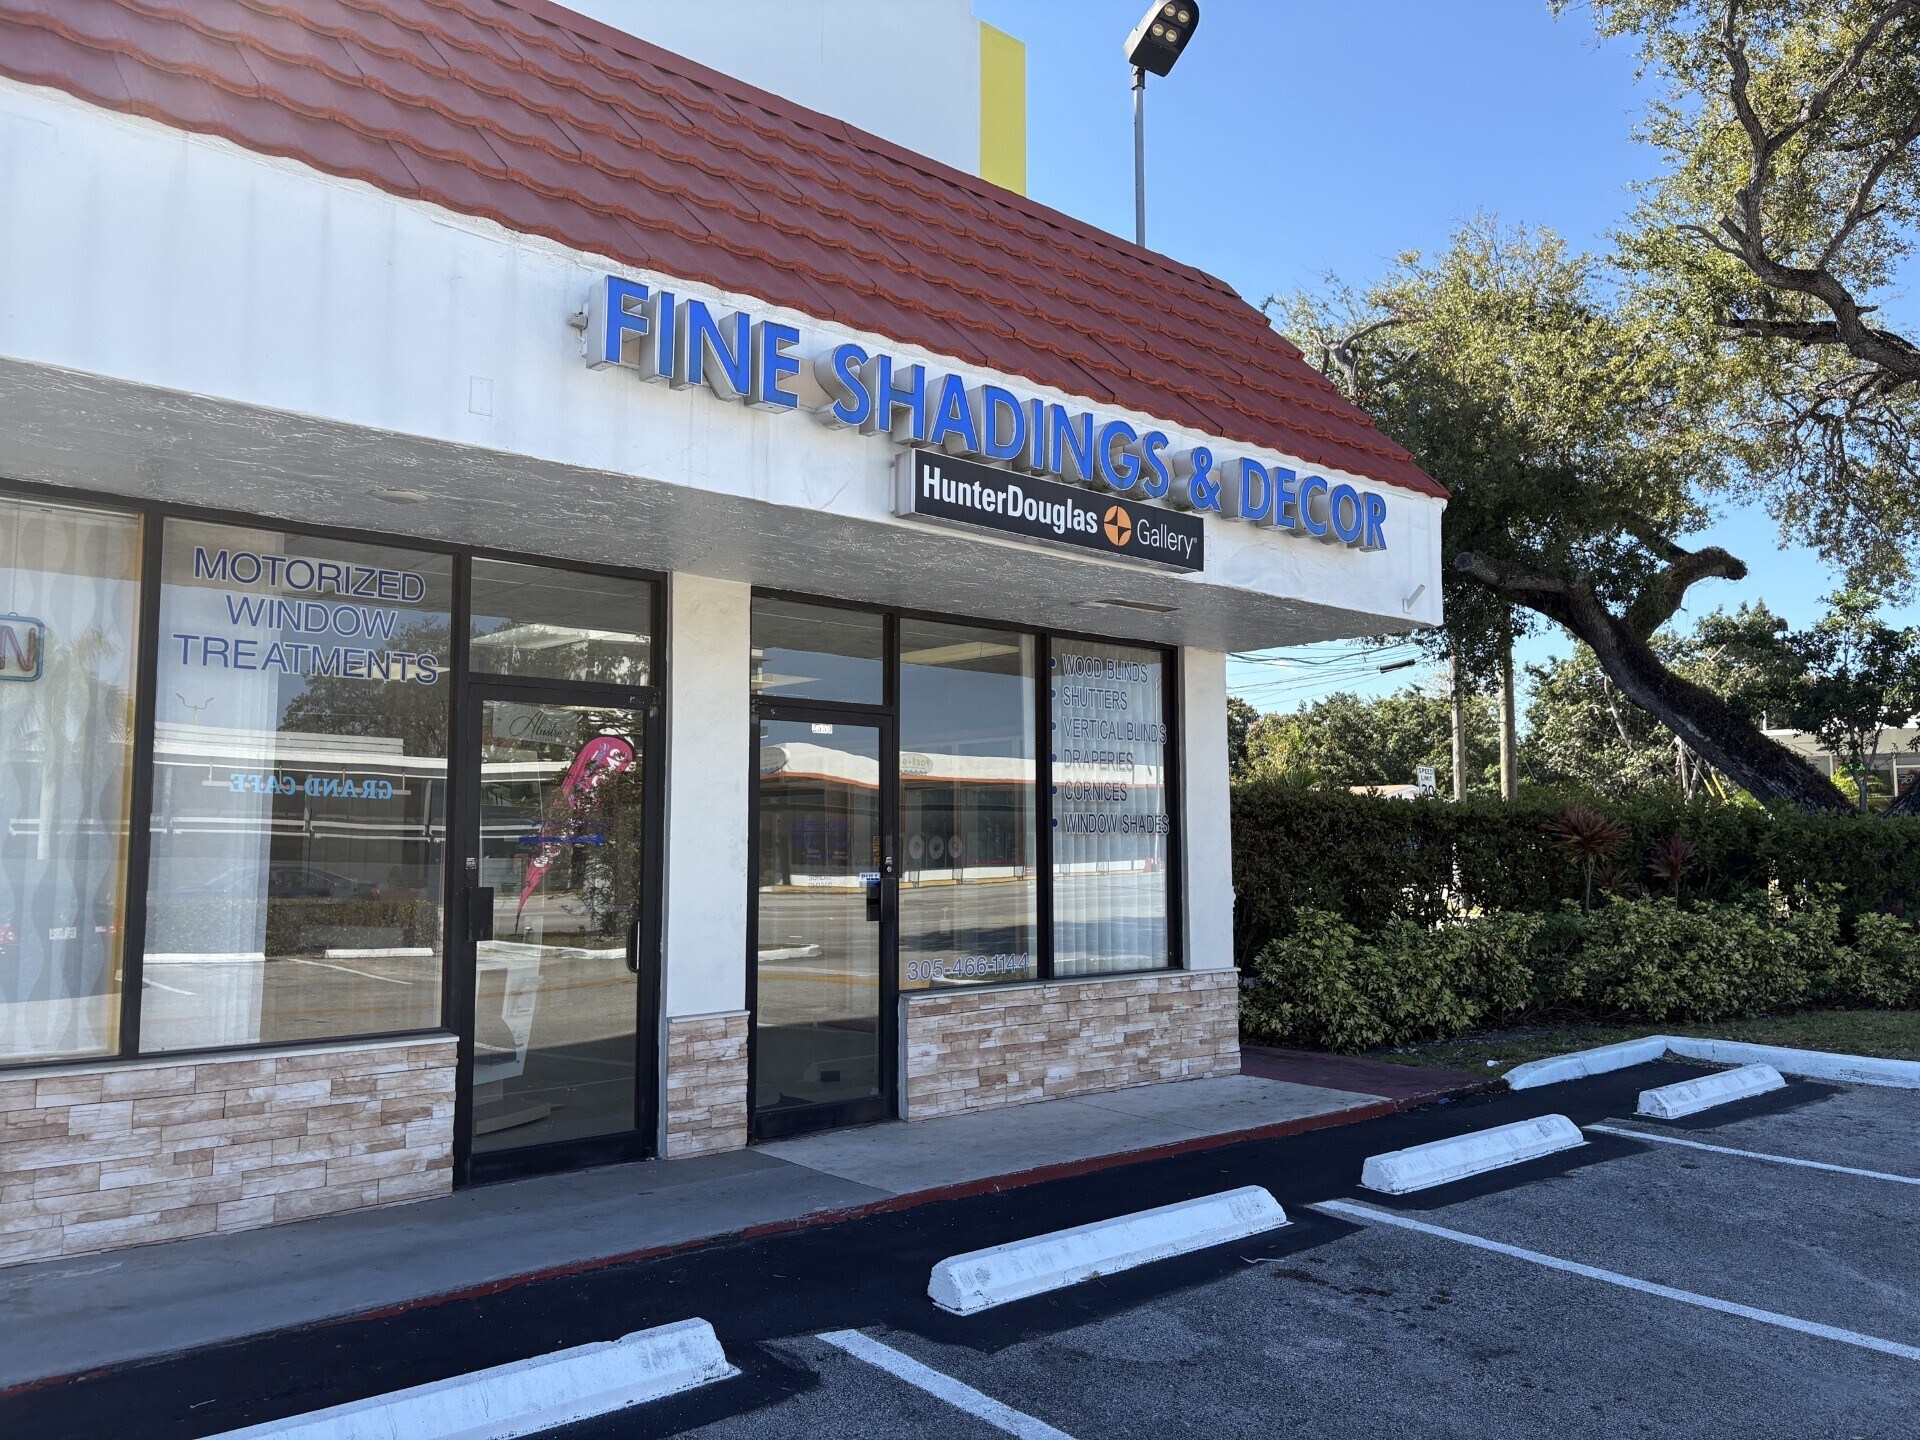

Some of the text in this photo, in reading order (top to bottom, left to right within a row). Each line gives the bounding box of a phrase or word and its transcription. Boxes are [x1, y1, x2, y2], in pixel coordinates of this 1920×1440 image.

[603, 274, 1387, 550] FINE SHADINGS & DECOR
[922, 464, 1098, 534] HunterDouglas
[193, 546, 425, 602] MOTORIZED
[225, 594, 398, 640] WINDOW
[172, 633, 438, 685] TREATMENTS
[1062, 654, 1148, 683] WOOD BLINDS
[1063, 686, 1128, 711] SHUTTERS
[1063, 717, 1167, 744] VERTICAL BLINDS
[1063, 748, 1134, 772] DRAPERIES
[1418, 767, 1434, 775] SPEED
[1063, 780, 1128, 802] CORNICES
[1064, 812, 1169, 834] WINDOW SHADES
[906, 952, 1029, 982] 305-466-1144
